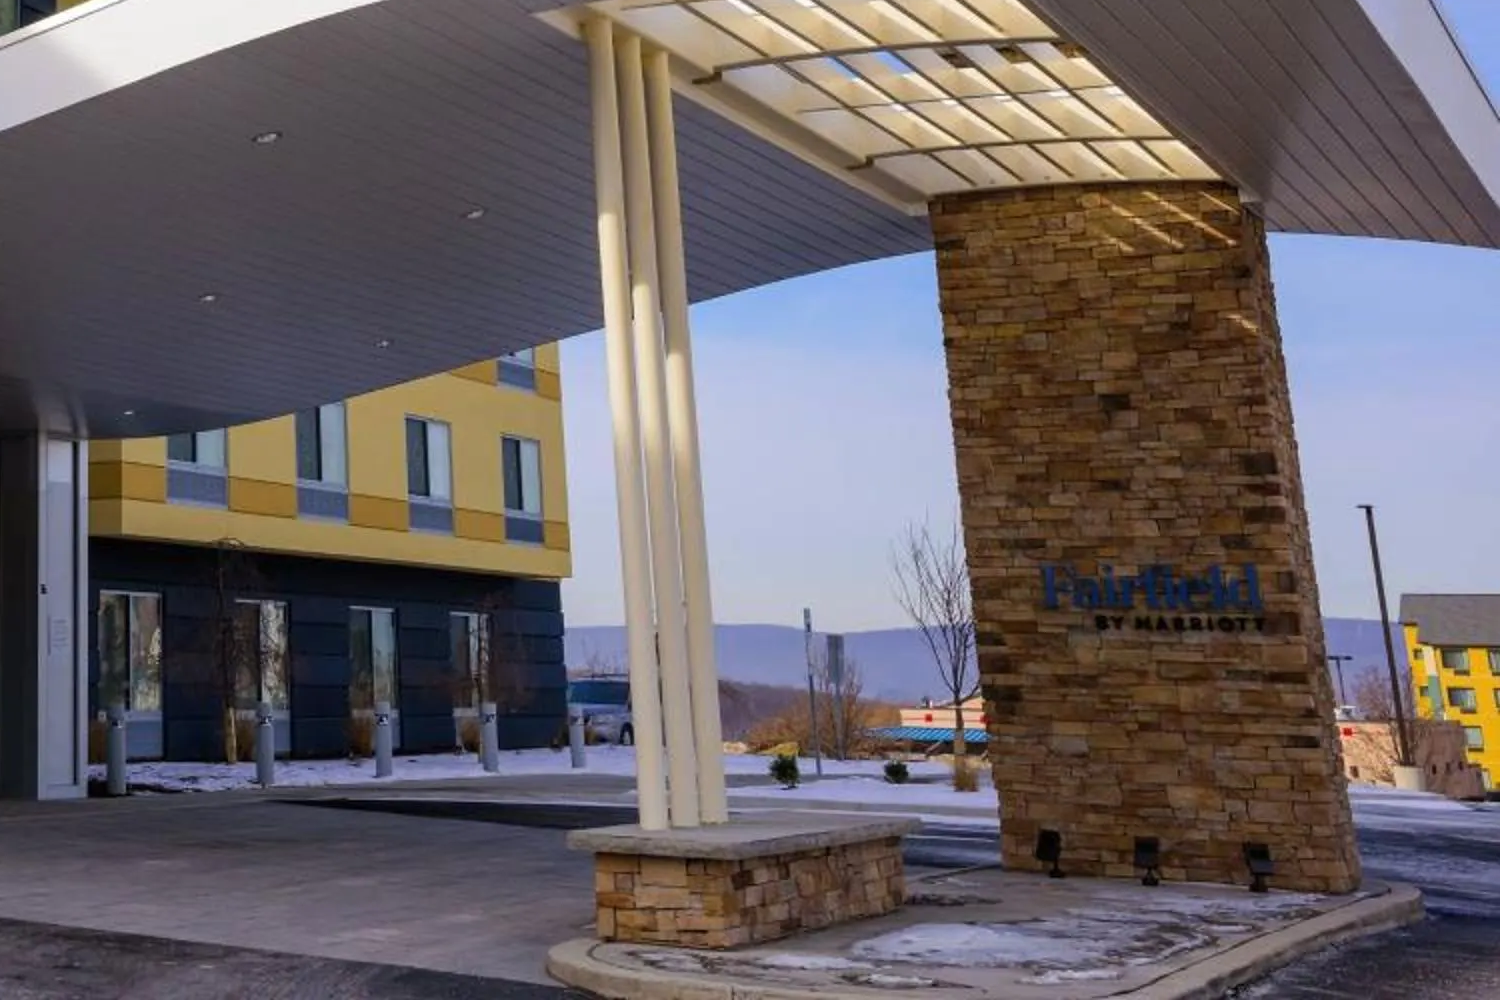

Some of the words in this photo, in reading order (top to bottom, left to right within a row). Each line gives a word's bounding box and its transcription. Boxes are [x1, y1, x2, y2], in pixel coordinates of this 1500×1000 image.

[1040, 562, 1264, 612] Fairfield
[1094, 615, 1124, 631] BY
[1135, 615, 1267, 632] MARRIOTT
